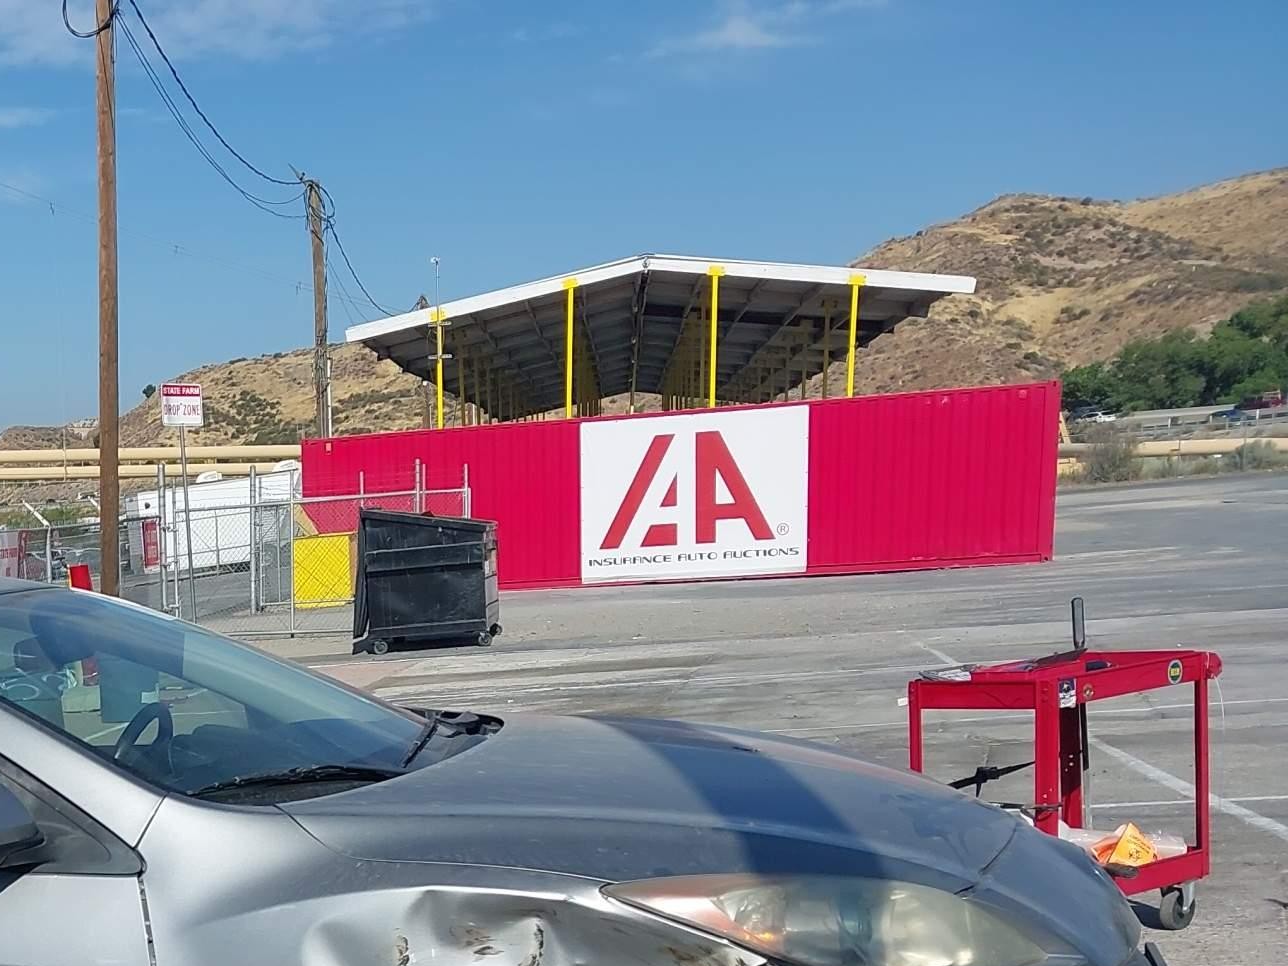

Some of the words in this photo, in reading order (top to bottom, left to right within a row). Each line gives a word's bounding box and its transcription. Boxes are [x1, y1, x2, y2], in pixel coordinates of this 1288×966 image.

[163, 387, 181, 395] STATE
[182, 387, 200, 395] FARM
[164, 404, 181, 416] DROP
[183, 404, 200, 416] ZONE
[588, 554, 672, 567] INSURANCE
[677, 551, 717, 562] AUTO
[723, 547, 800, 560] AUCTIONS
